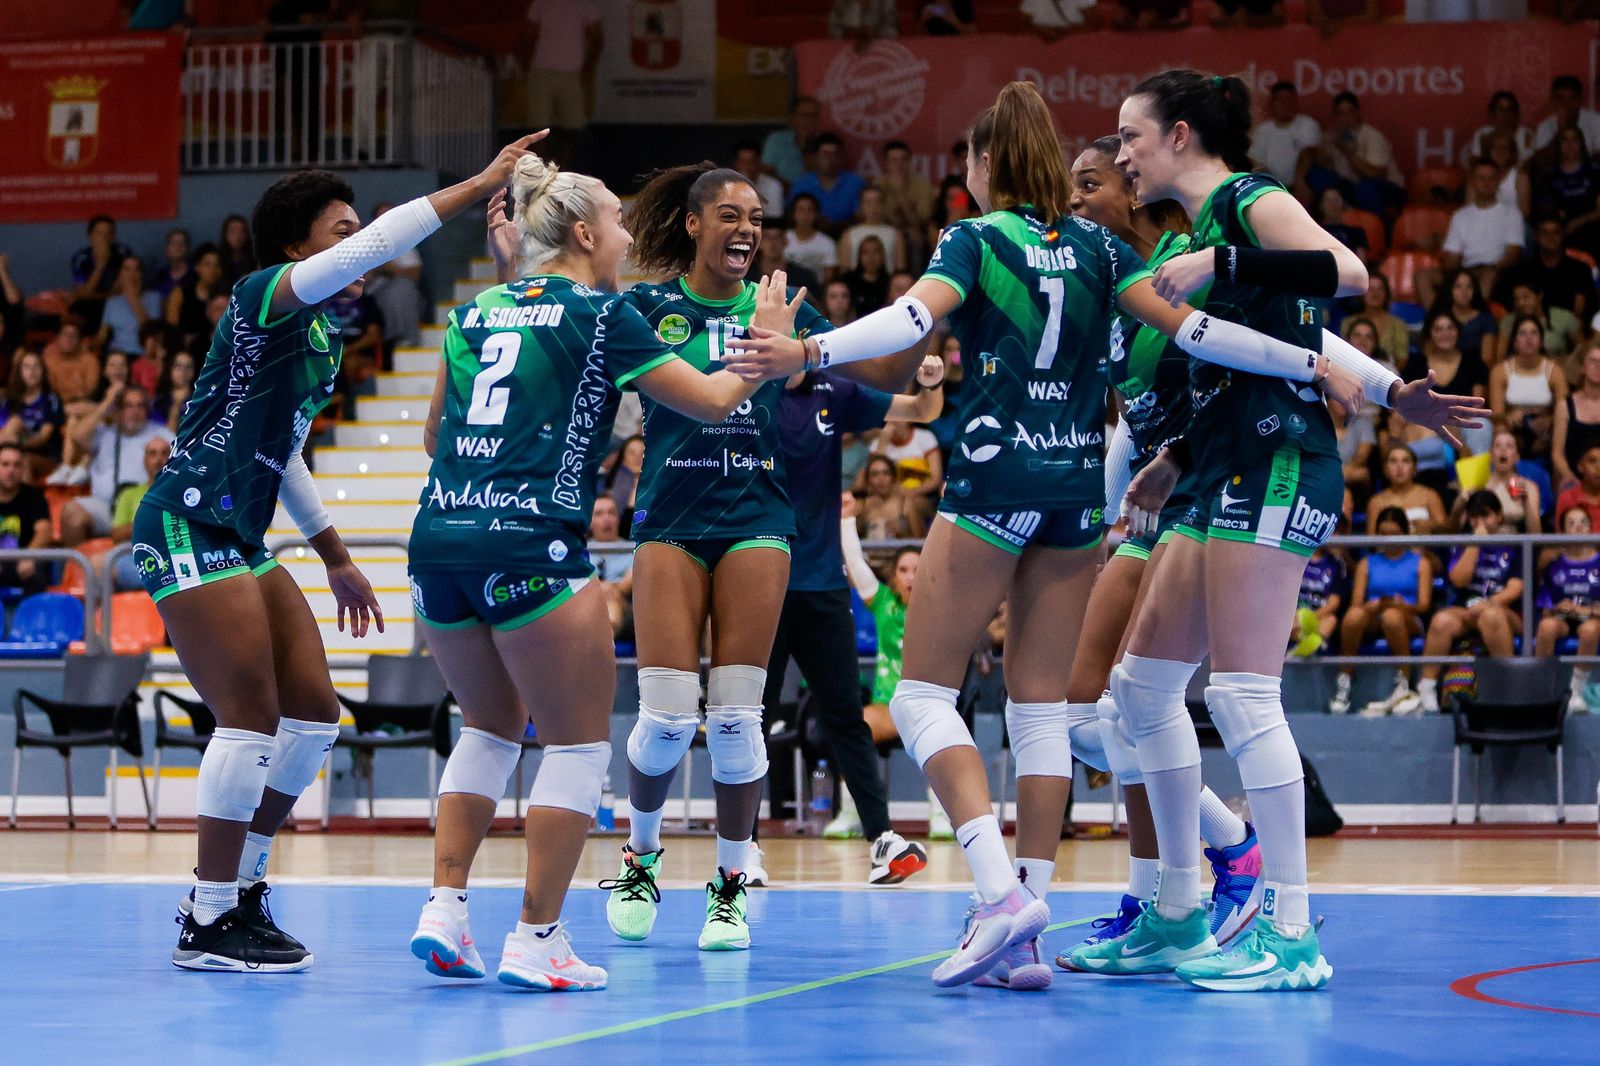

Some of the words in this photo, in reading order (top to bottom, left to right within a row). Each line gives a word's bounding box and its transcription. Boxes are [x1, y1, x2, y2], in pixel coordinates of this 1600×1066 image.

[1295, 59, 1465, 98] Deportes
[462, 308, 482, 328] M.
[484, 304, 565, 328] SAUCEDO
[1034, 276, 1065, 369] 7
[467, 331, 522, 425] 2
[1028, 381, 1073, 400] WAY
[702, 427, 761, 437] PROFESIONAL
[456, 436, 504, 458] WAY
[665, 457, 720, 469] Fundación
[732, 453, 775, 471] Cajasol
[427, 477, 546, 515] Andalucía
[970, 515, 1025, 546] ACKAGING
